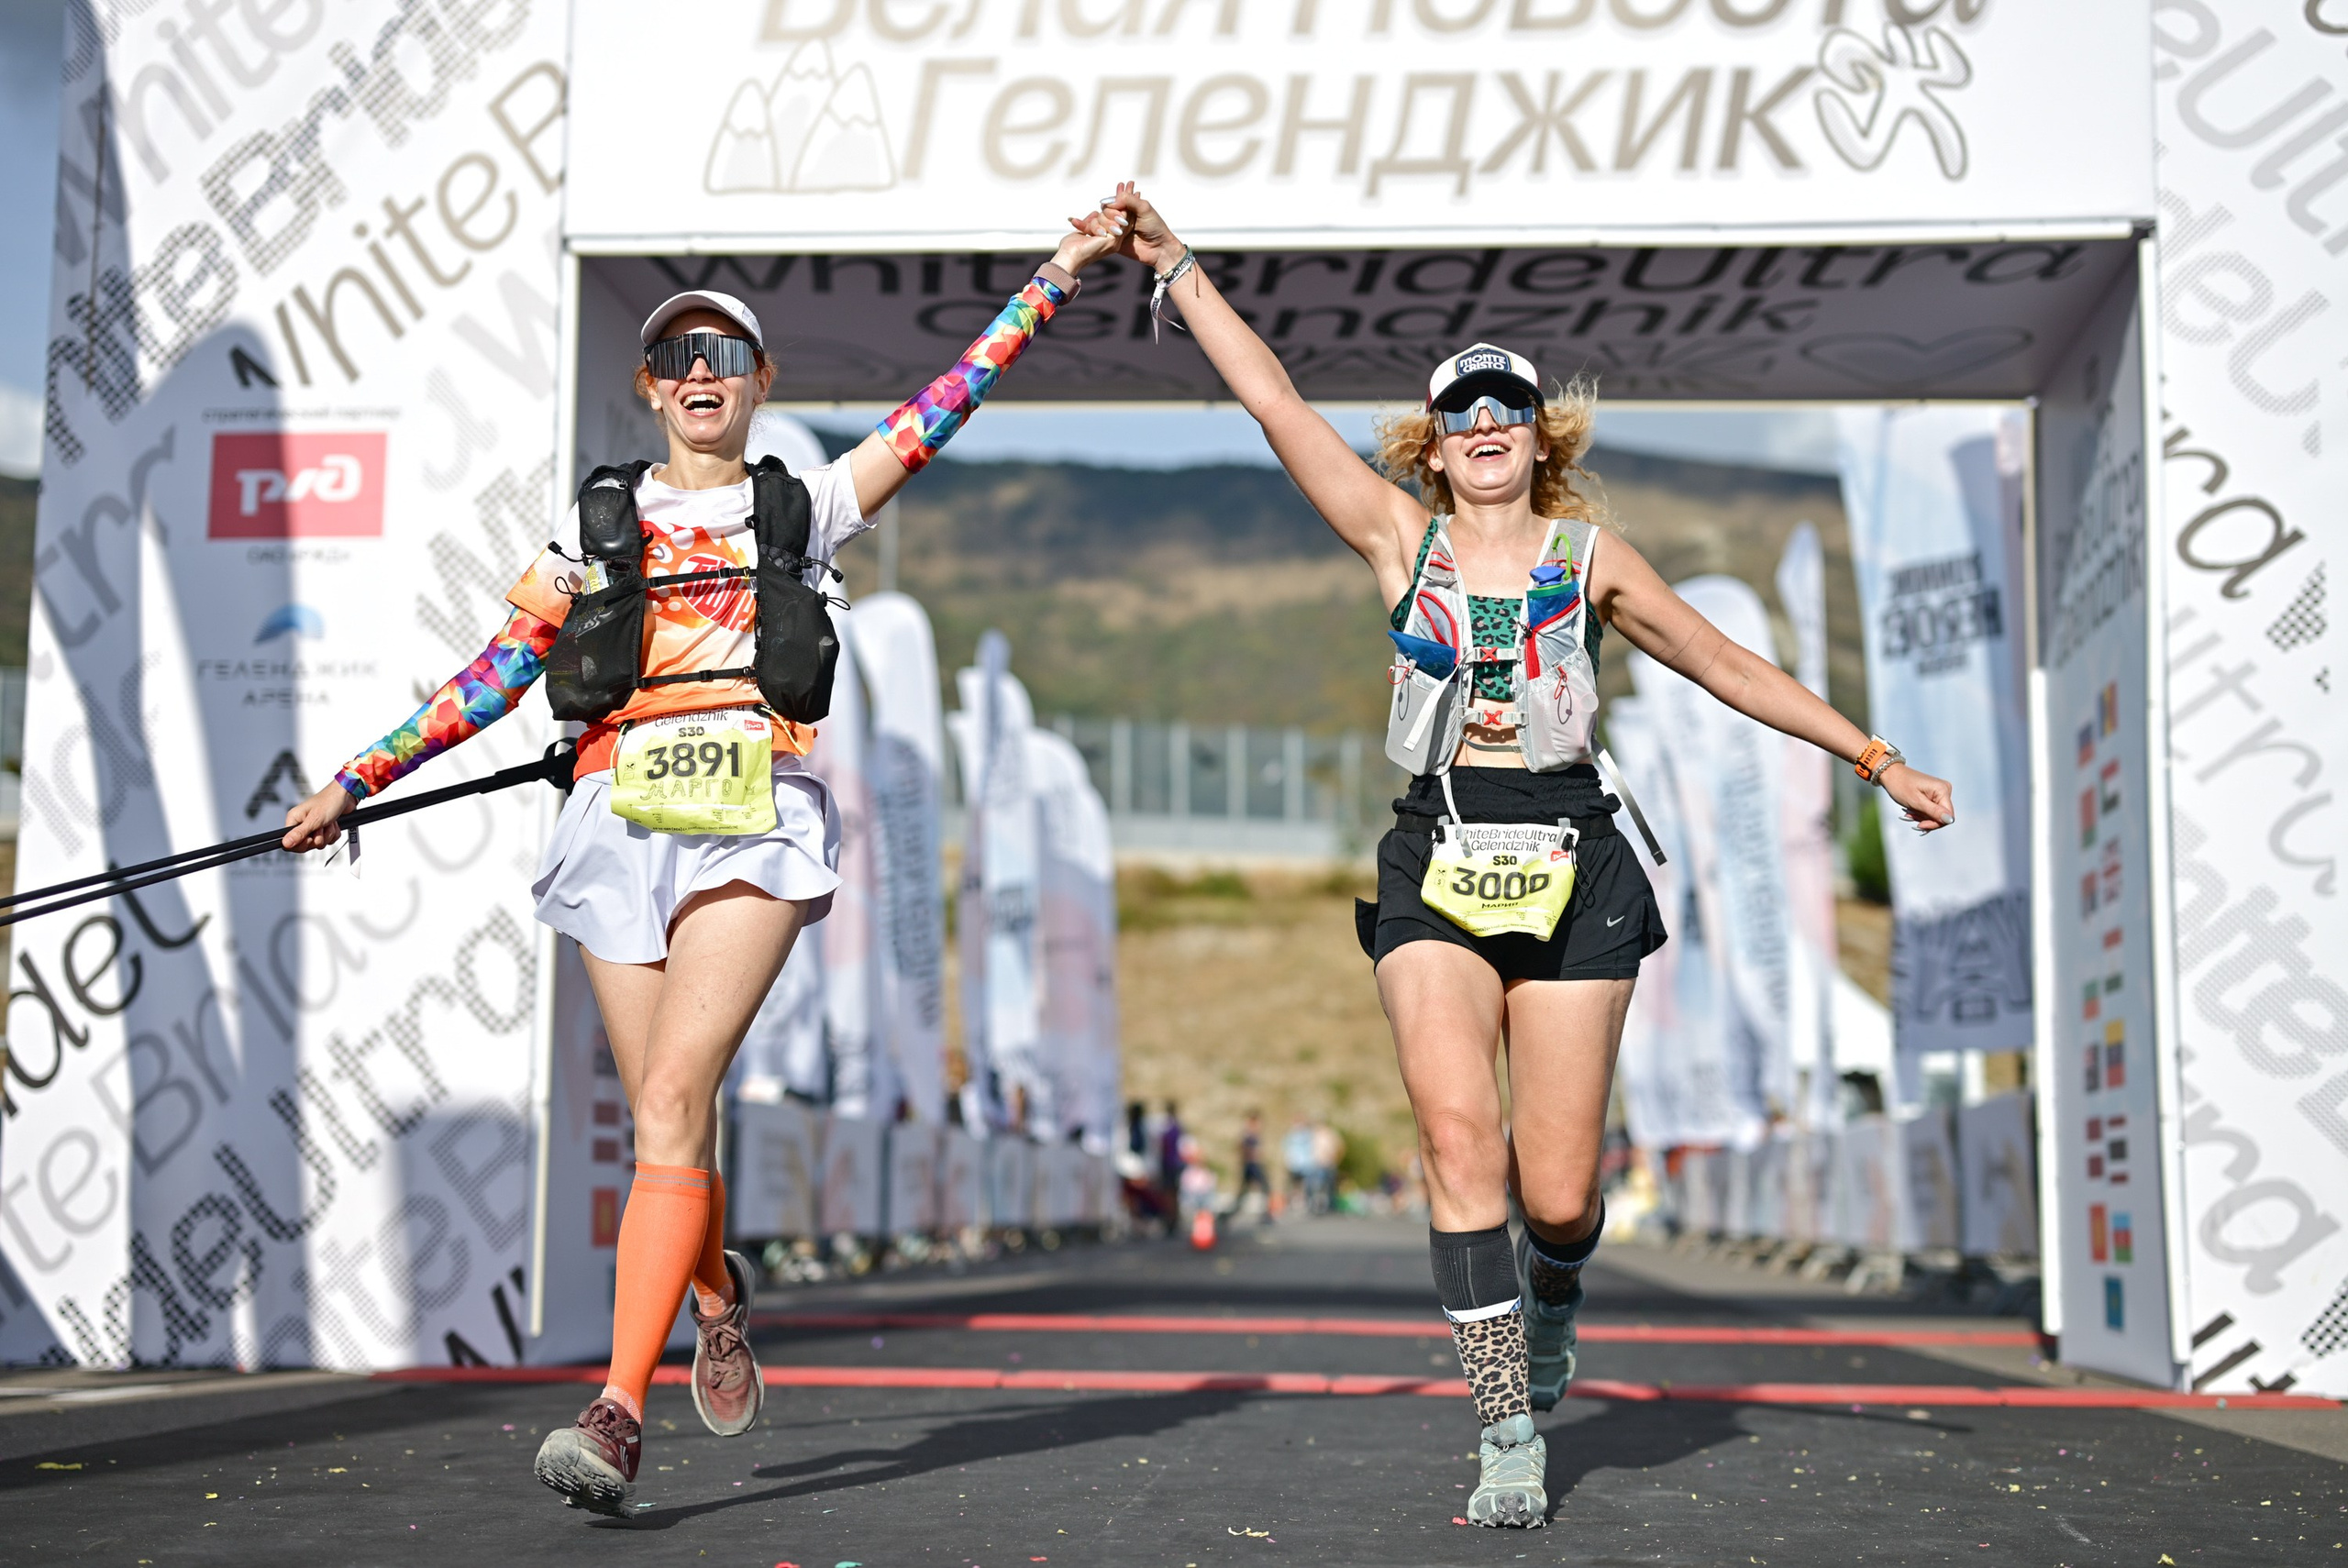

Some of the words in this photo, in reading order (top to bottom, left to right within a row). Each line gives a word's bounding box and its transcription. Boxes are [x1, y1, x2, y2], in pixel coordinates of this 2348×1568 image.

[1459, 353, 1506, 368] MONTE
[1462, 361, 1505, 373] CRISTO
[655, 711, 729, 727] Gelendzhik
[678, 726, 705, 738] S30
[646, 741, 740, 779] 3891
[1471, 840, 1541, 853] Gelendzhik
[1492, 855, 1518, 866] S30
